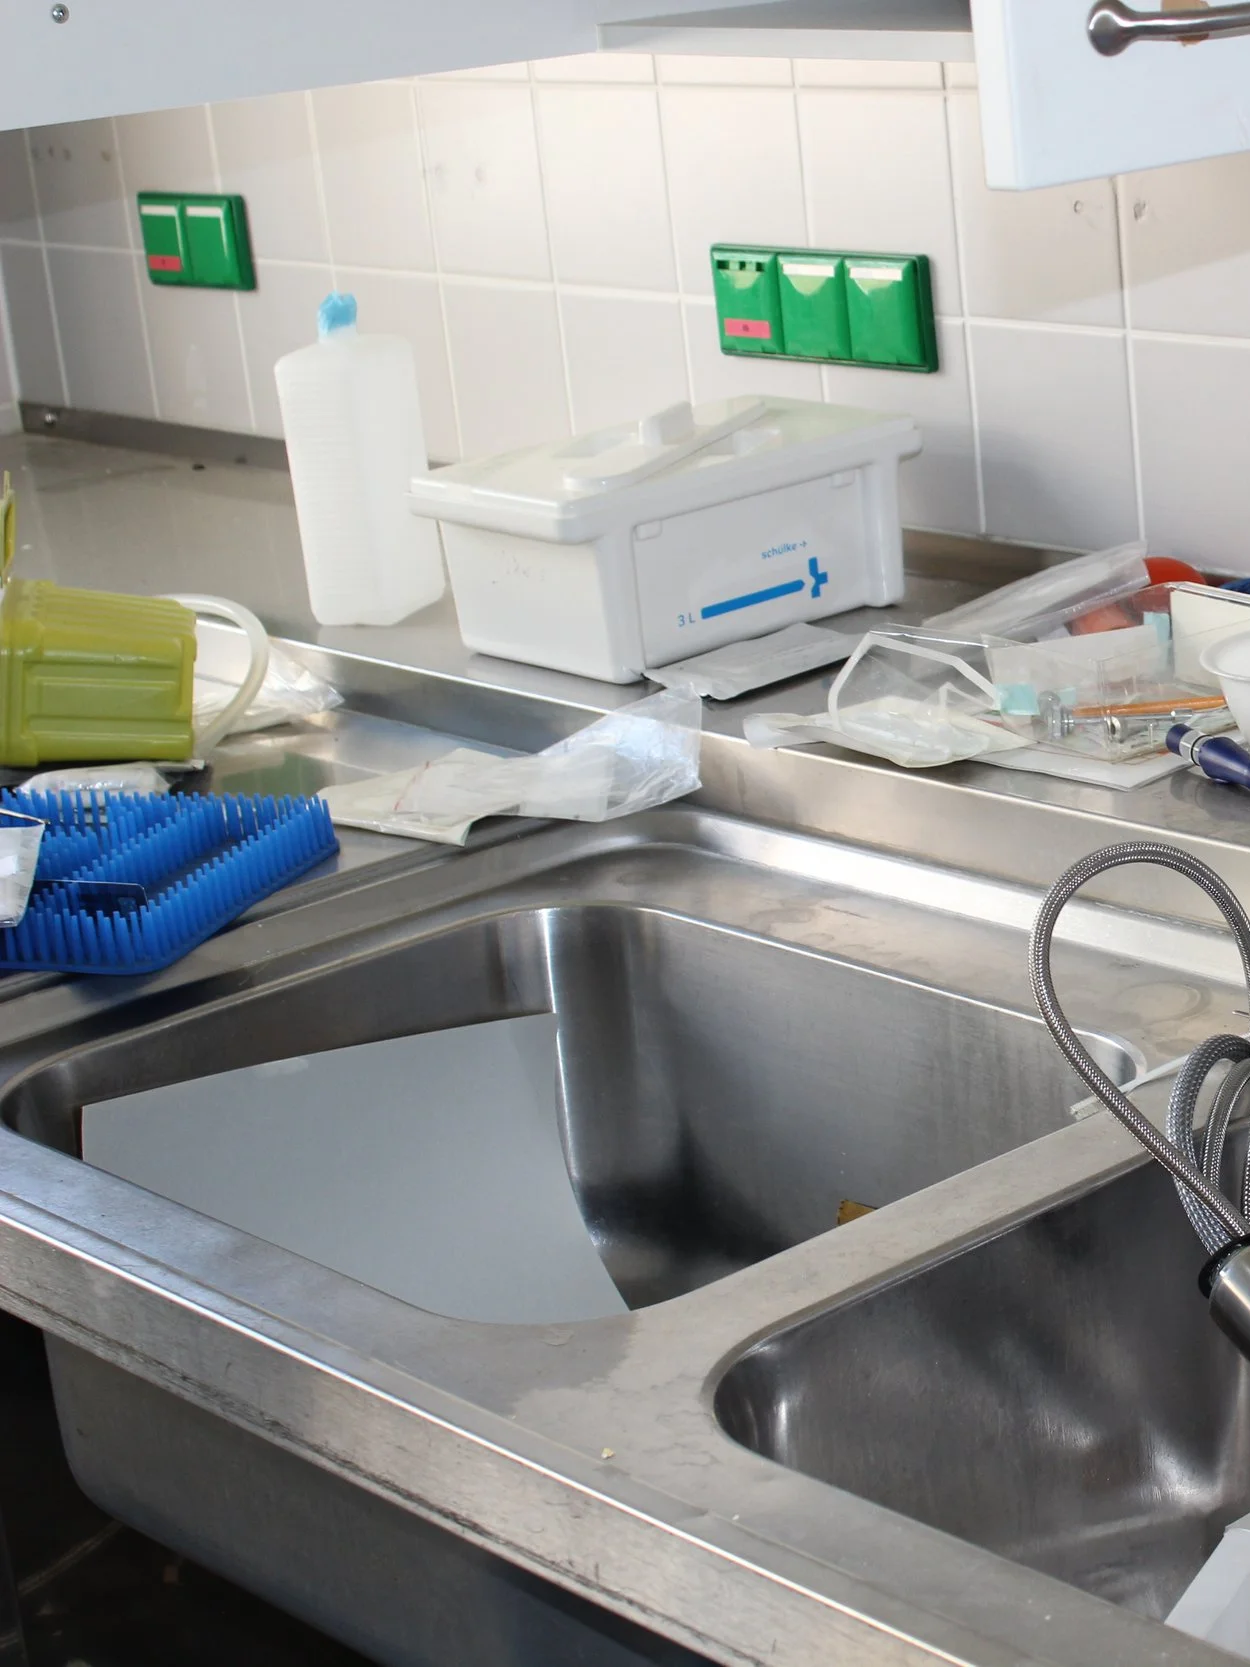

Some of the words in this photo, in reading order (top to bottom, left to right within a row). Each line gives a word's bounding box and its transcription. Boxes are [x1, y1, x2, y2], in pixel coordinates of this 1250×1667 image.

[762, 542, 797, 559] schülke
[677, 615, 685, 627] 3
[688, 612, 695, 623] L
